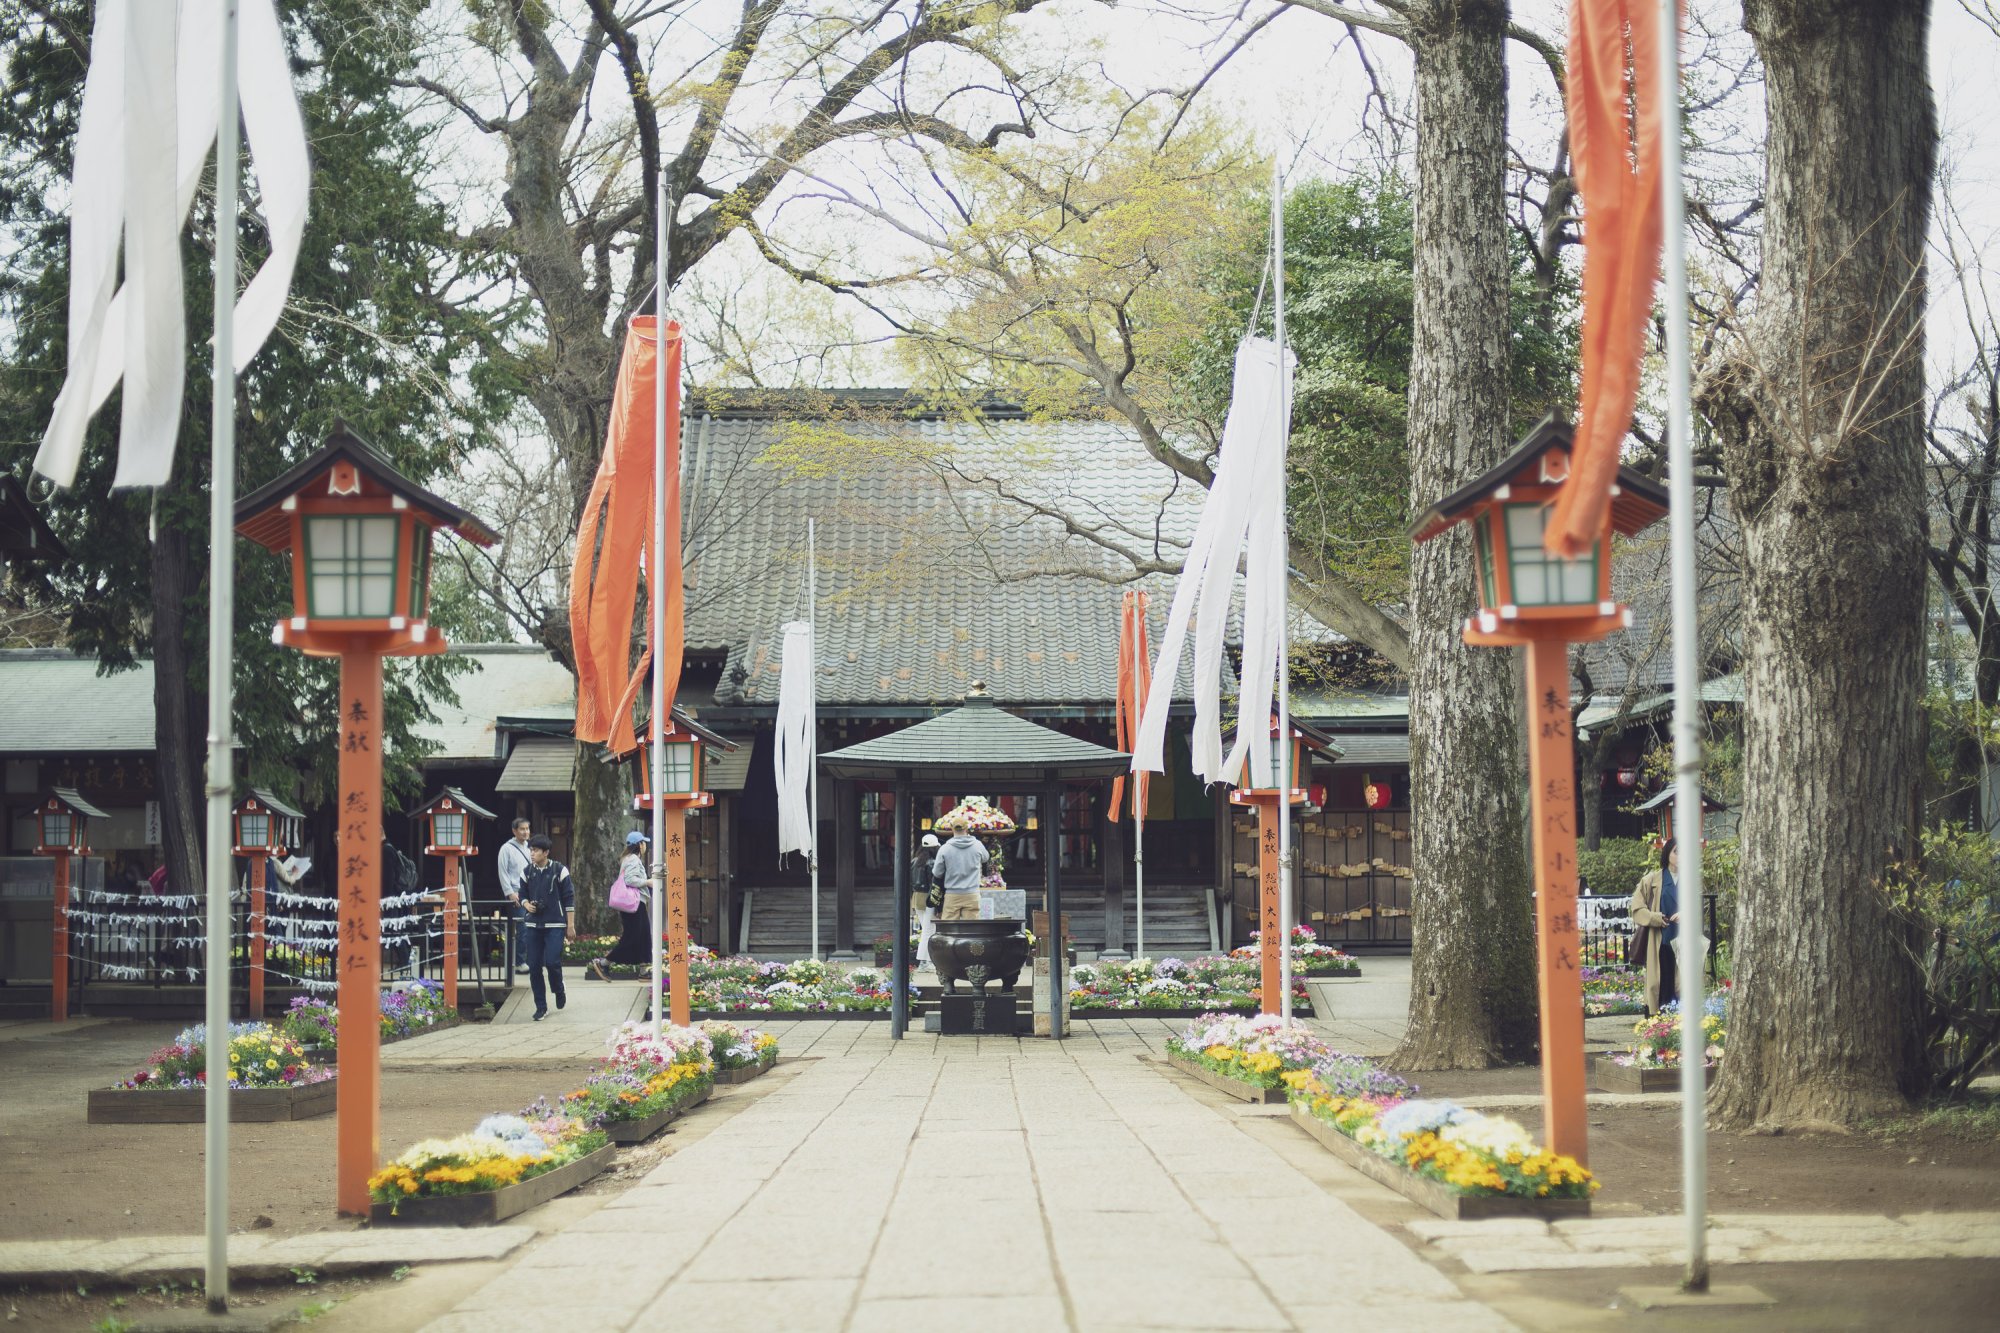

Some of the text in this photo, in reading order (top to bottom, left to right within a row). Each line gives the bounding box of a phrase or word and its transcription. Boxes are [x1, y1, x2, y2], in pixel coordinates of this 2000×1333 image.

[345, 697, 371, 753] 奉献
[669, 832, 681, 857] 奉献
[1264, 827, 1276, 854] 奉献
